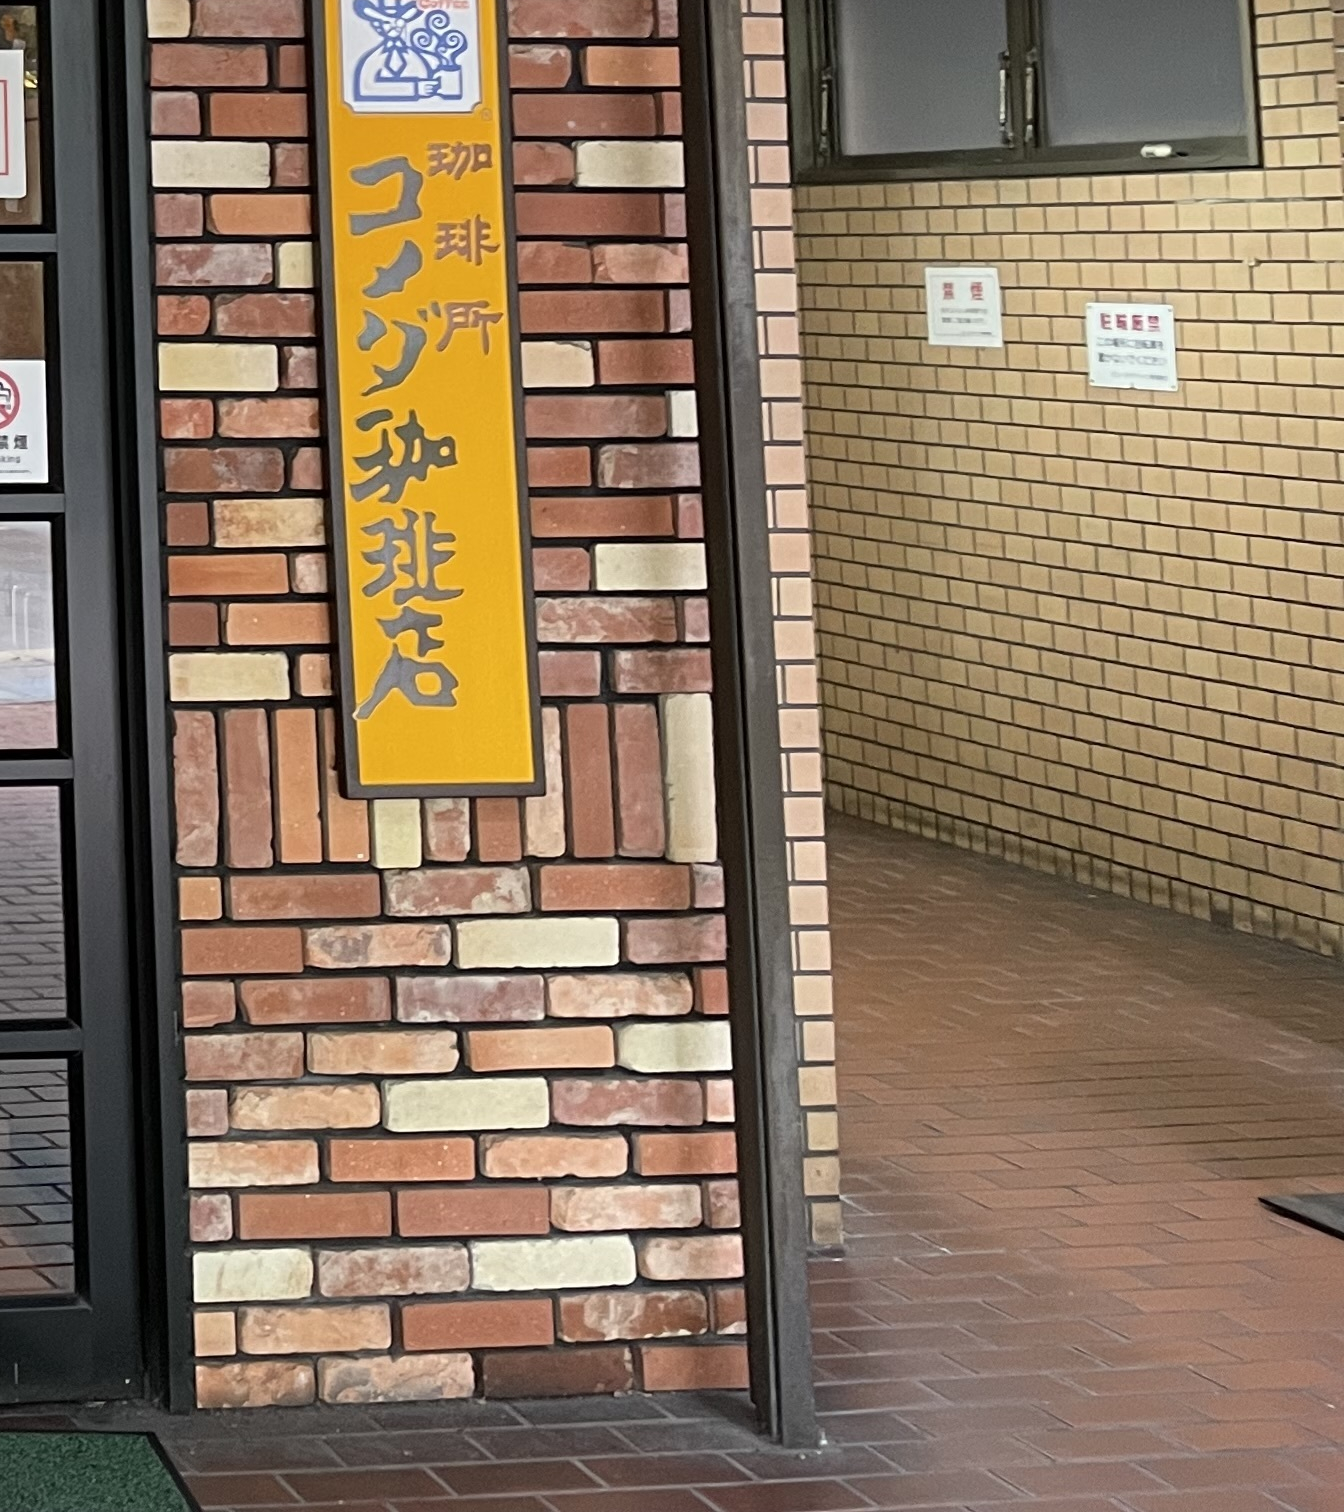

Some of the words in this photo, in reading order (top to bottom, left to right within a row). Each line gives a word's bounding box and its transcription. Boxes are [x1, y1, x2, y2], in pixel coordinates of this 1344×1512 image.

[348, 156, 464, 719] コメダ珈琲店
[427, 141, 504, 356] 珈琲所
